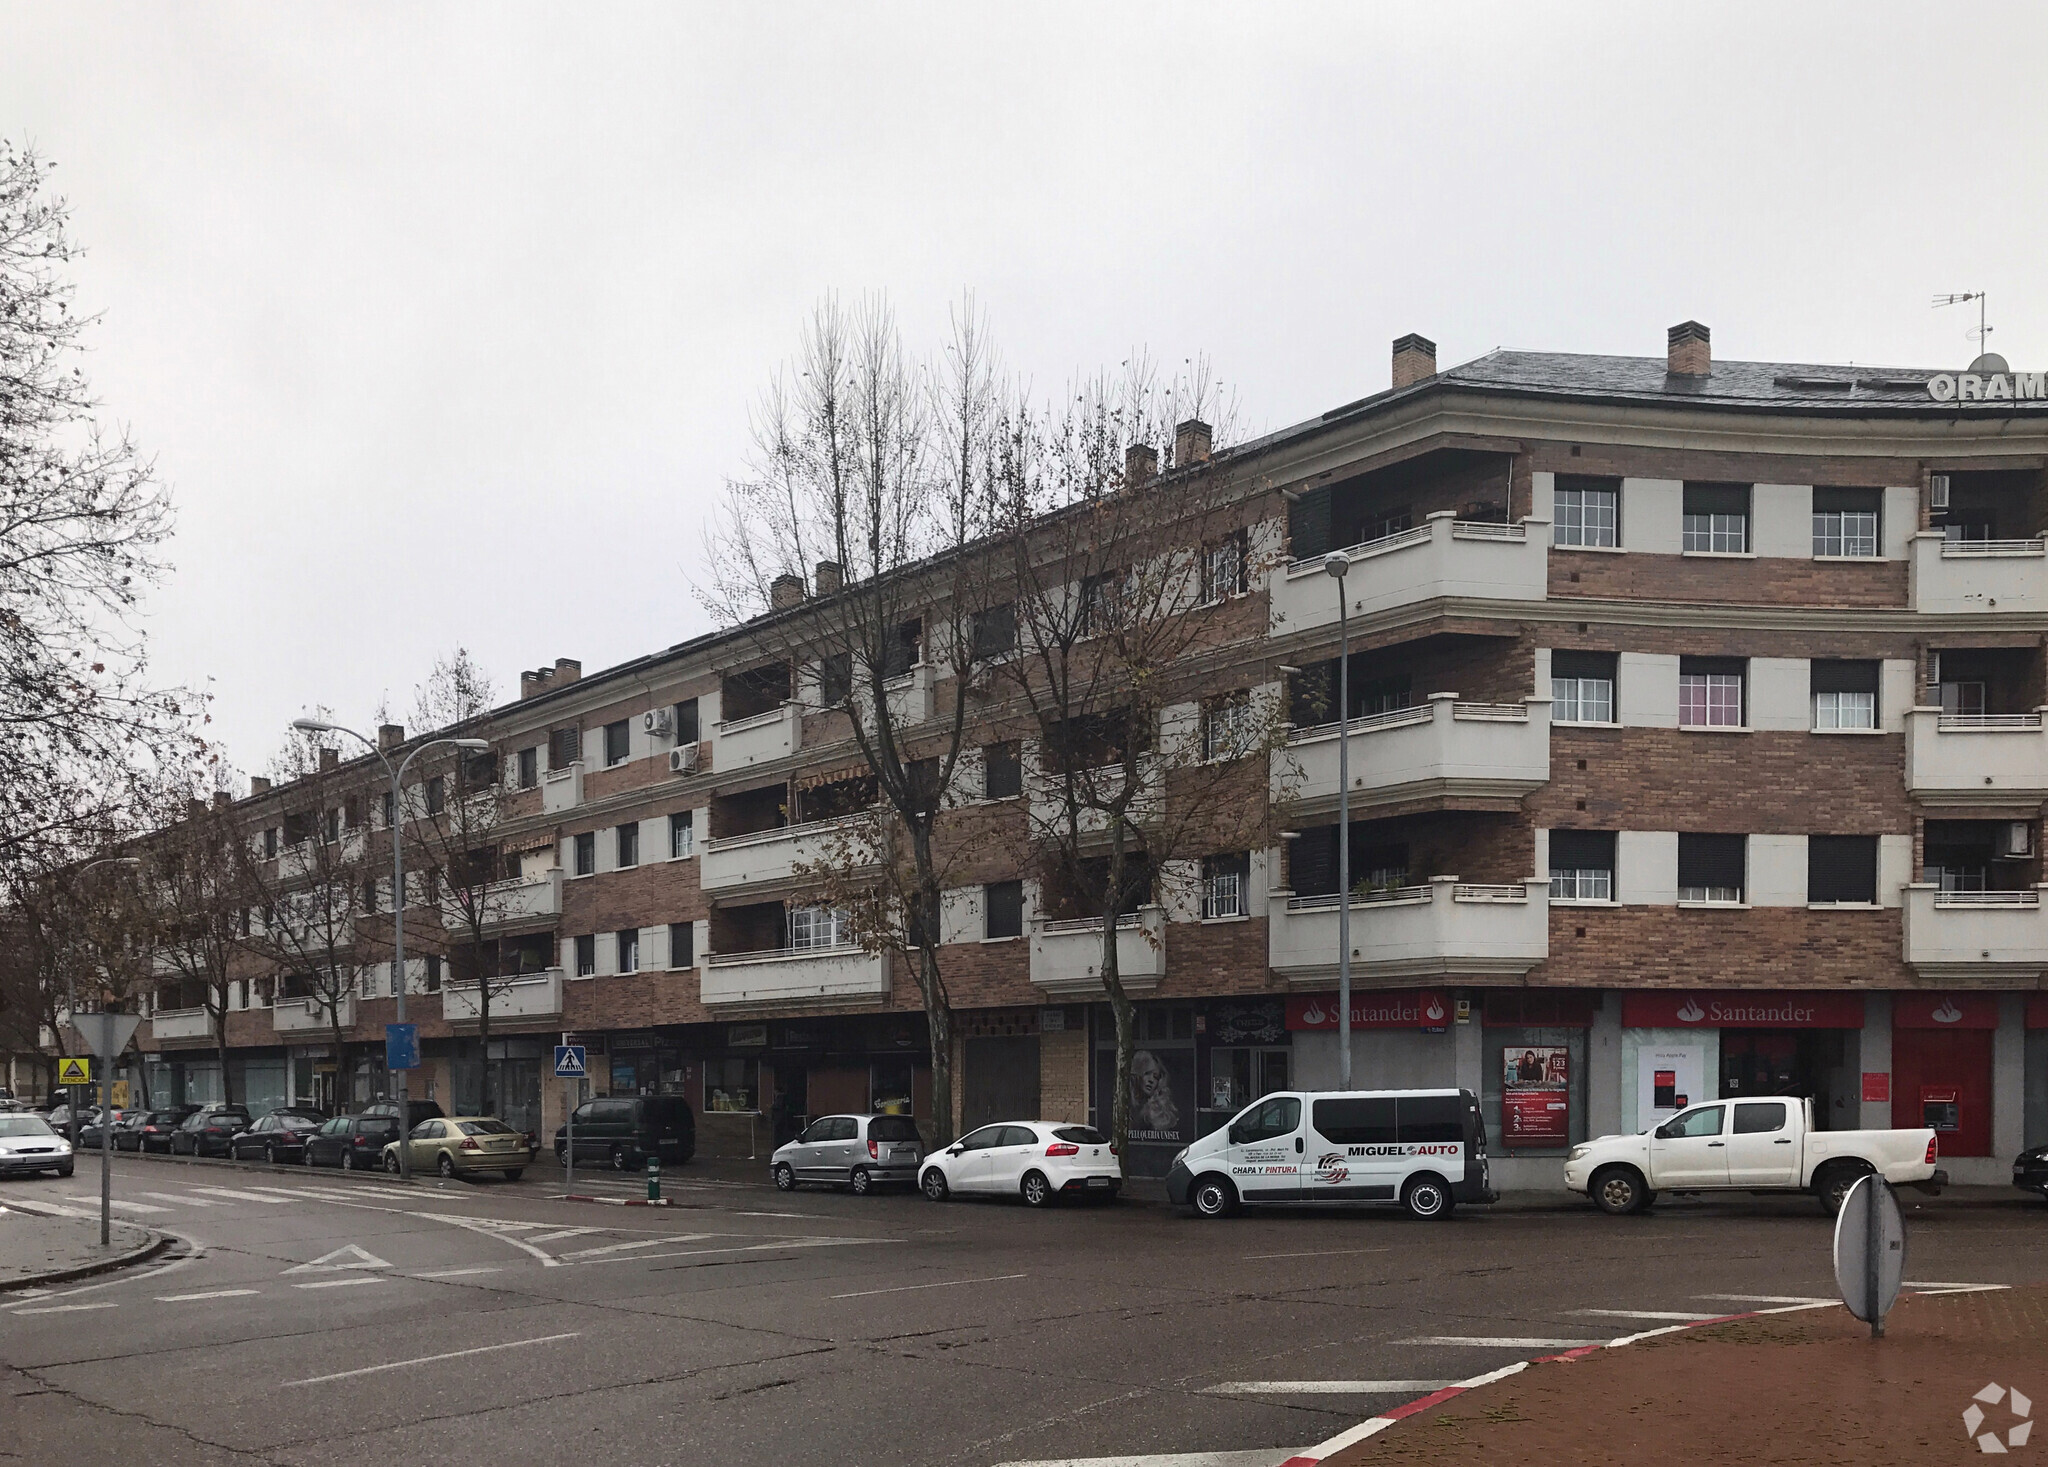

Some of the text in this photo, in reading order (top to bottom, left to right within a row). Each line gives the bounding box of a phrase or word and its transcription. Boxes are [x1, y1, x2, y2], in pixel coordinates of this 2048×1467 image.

[1927, 373, 2046, 401] ORAM
[1330, 1000, 1420, 1022] Sntander
[1710, 1002, 1815, 1022] Santander
[1160, 1131, 1180, 1140] UNISEX
[1348, 1145, 1458, 1156] MIGUEL AUTO
[1232, 1166, 1297, 1174] CHAPA Y PINTURA
